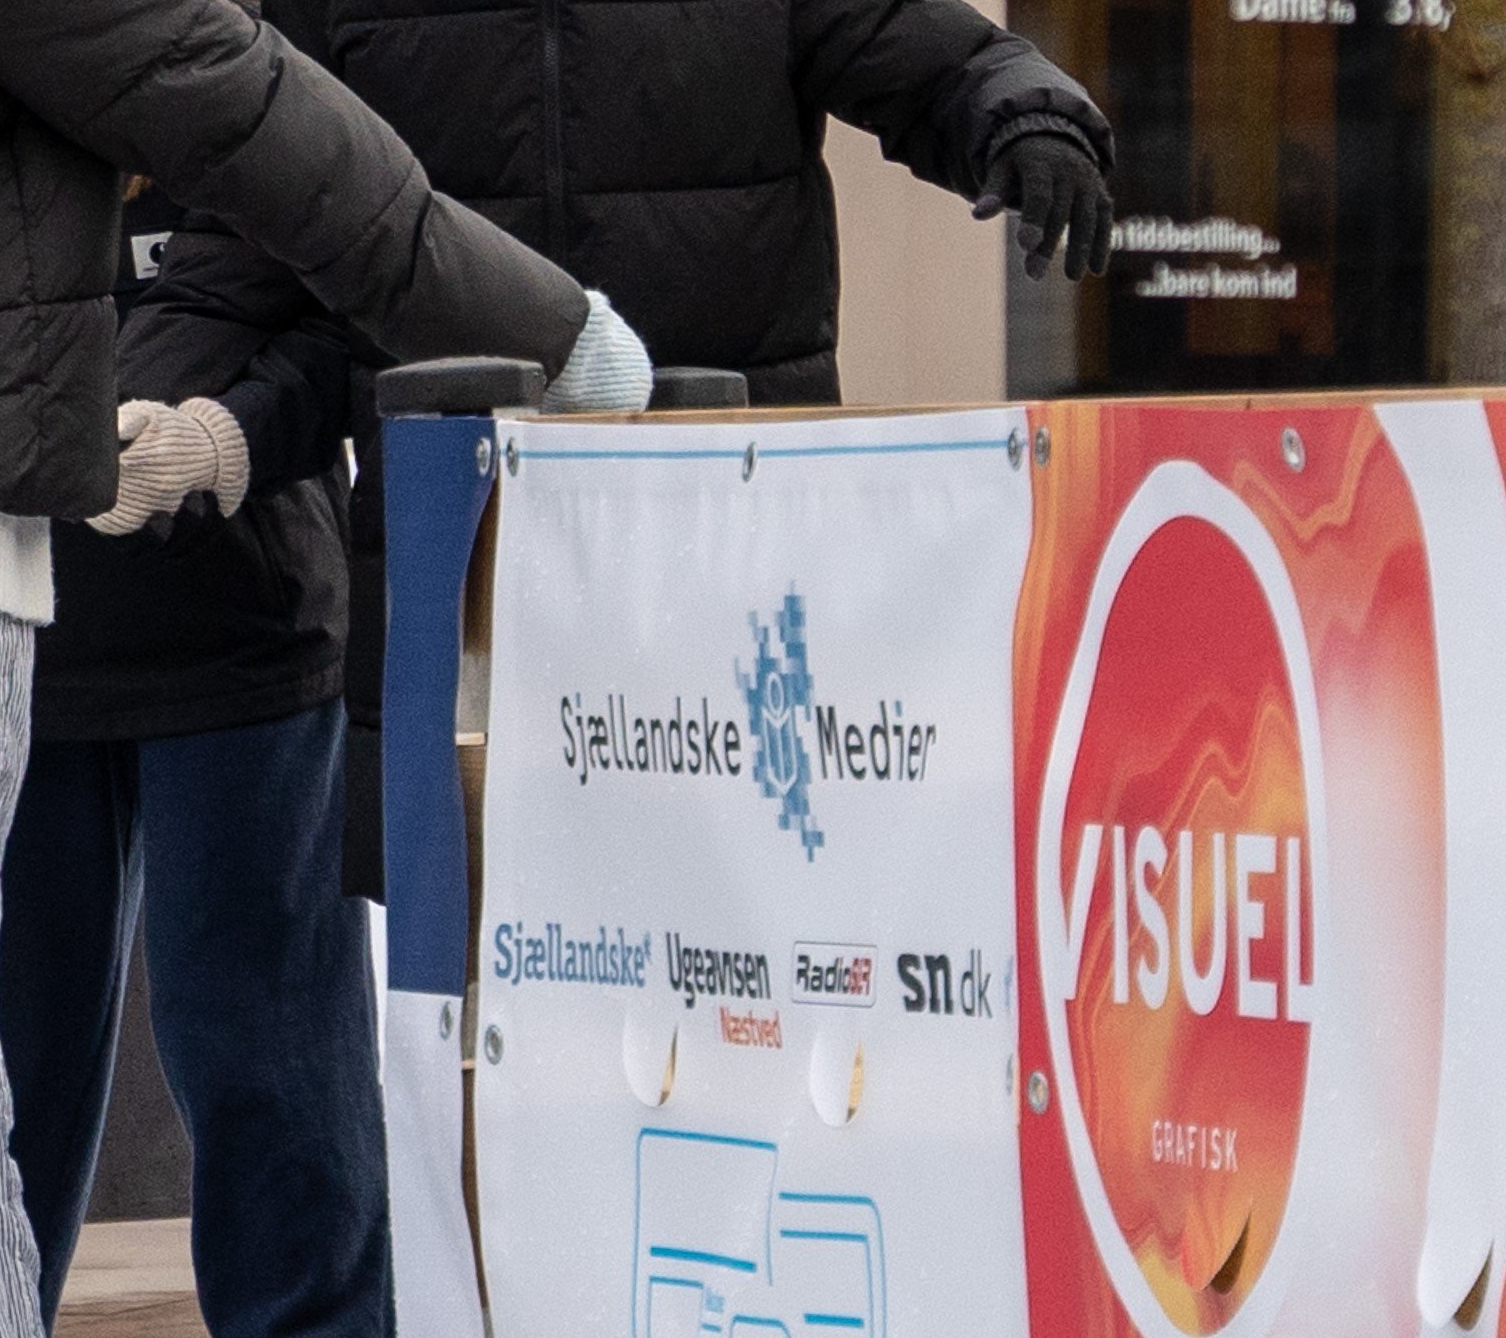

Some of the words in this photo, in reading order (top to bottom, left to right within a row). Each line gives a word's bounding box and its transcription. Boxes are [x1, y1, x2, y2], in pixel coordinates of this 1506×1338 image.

[561, 694, 741, 785] Sjællandske
[816, 699, 937, 782] Medier
[493, 923, 647, 989] Sjællandske
[665, 932, 772, 1009] Ugeavisen
[719, 1005, 784, 1050] Næstved
[1150, 1118, 1240, 1172] GRAFISK
